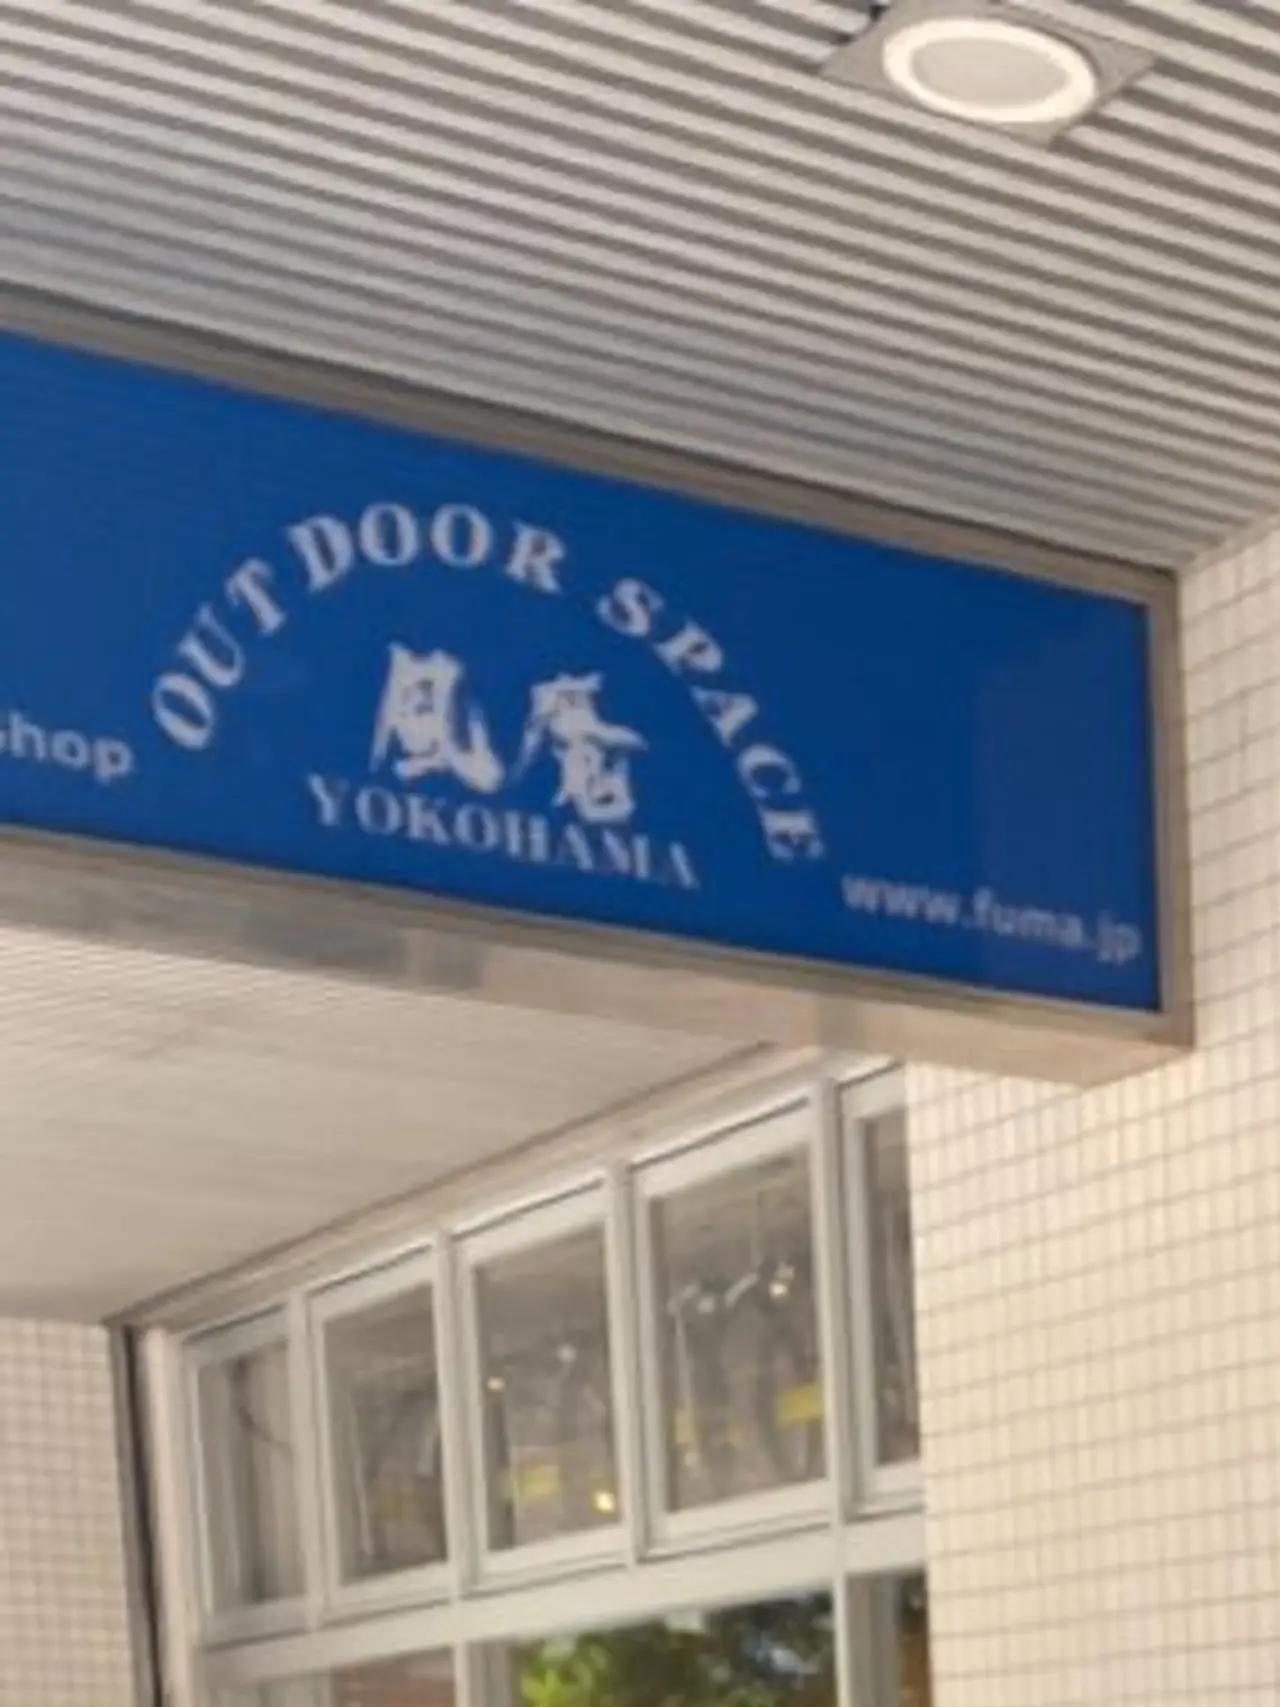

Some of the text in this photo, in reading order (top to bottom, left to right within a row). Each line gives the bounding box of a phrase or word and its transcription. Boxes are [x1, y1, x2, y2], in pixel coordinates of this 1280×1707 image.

[152, 502, 825, 864] OUT DOOR SPACE
[0, 710, 135, 785] hop
[307, 773, 699, 889] YOKOHAMA
[841, 873, 1141, 965] www.fuma.jp
